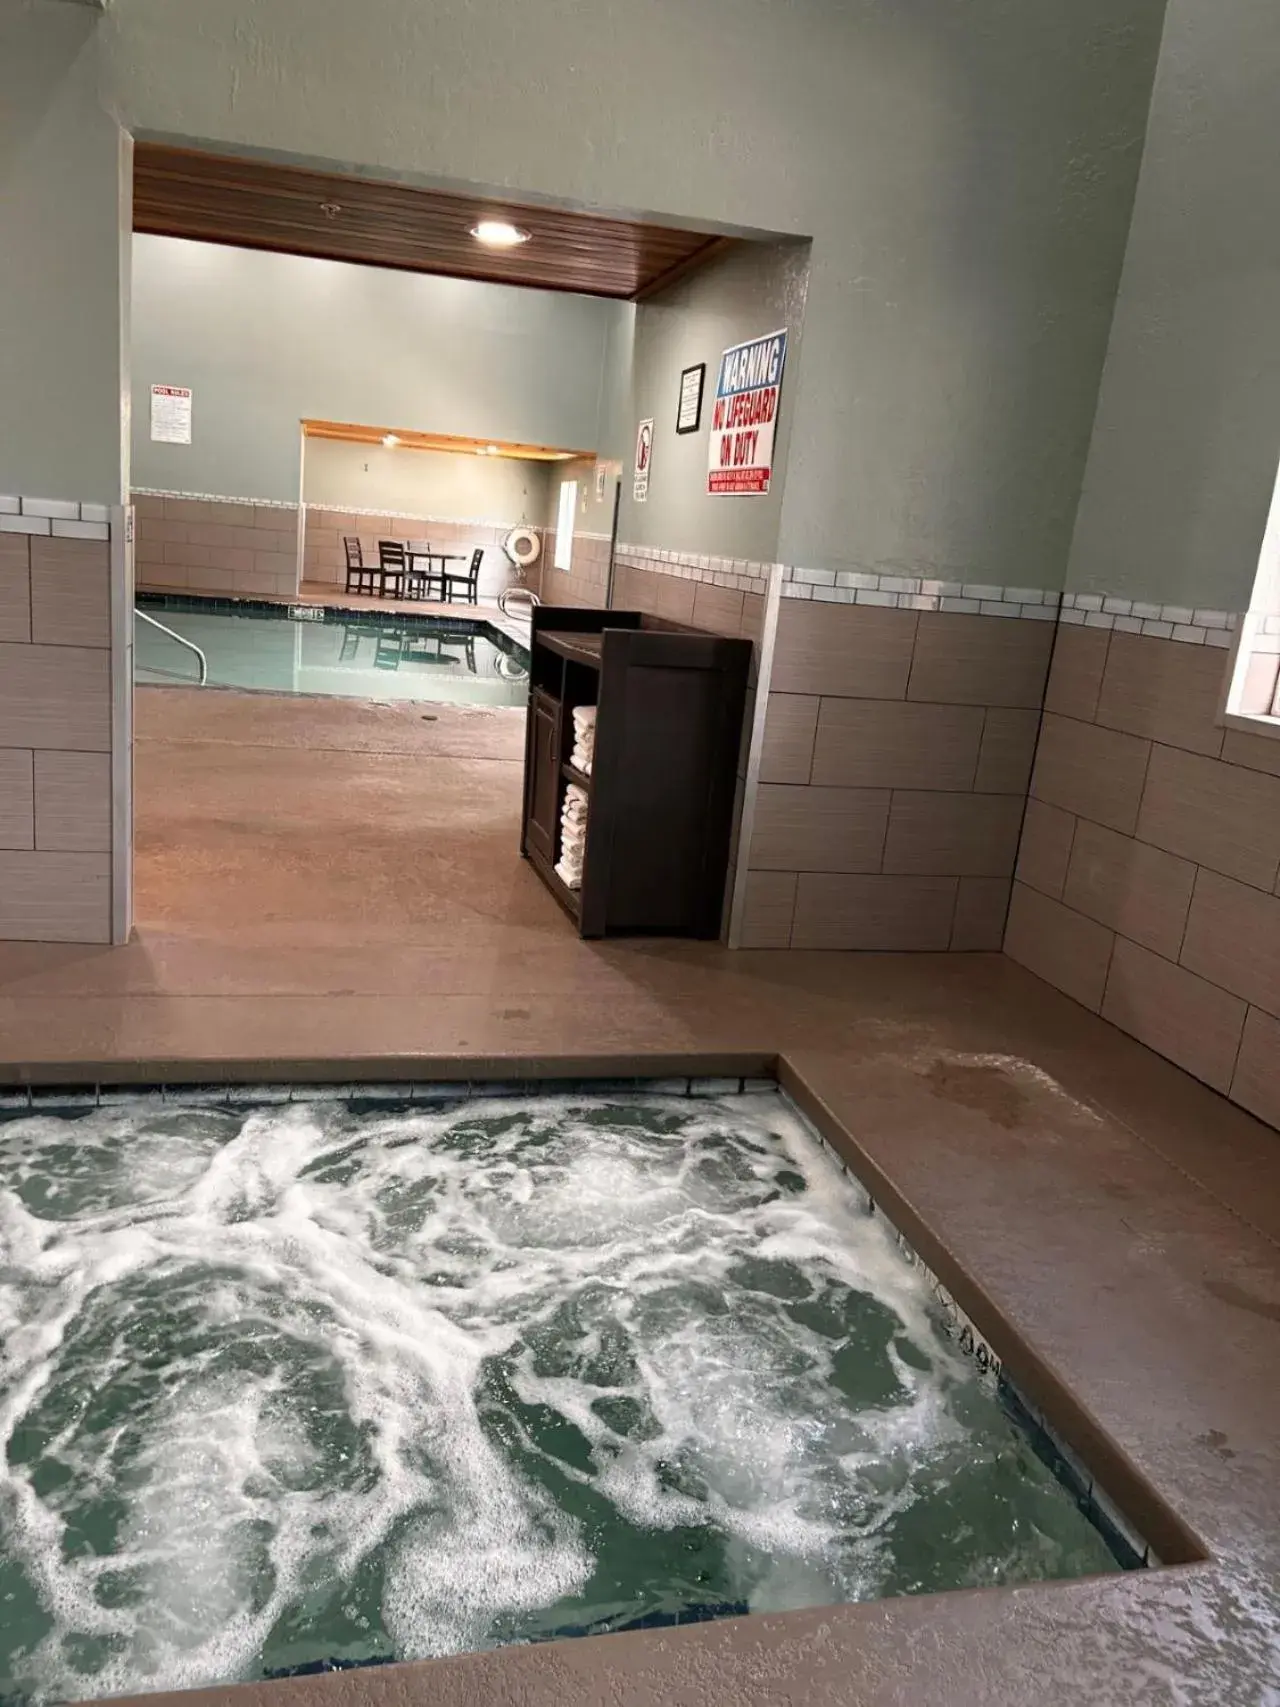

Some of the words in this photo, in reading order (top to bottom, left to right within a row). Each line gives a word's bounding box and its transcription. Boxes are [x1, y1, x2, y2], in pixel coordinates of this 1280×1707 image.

[722, 338, 780, 394] WARNING
[713, 399, 726, 431] NO
[726, 387, 777, 429] LIFEGUARD
[720, 433, 733, 467] ON
[733, 430, 759, 466] DUTY
